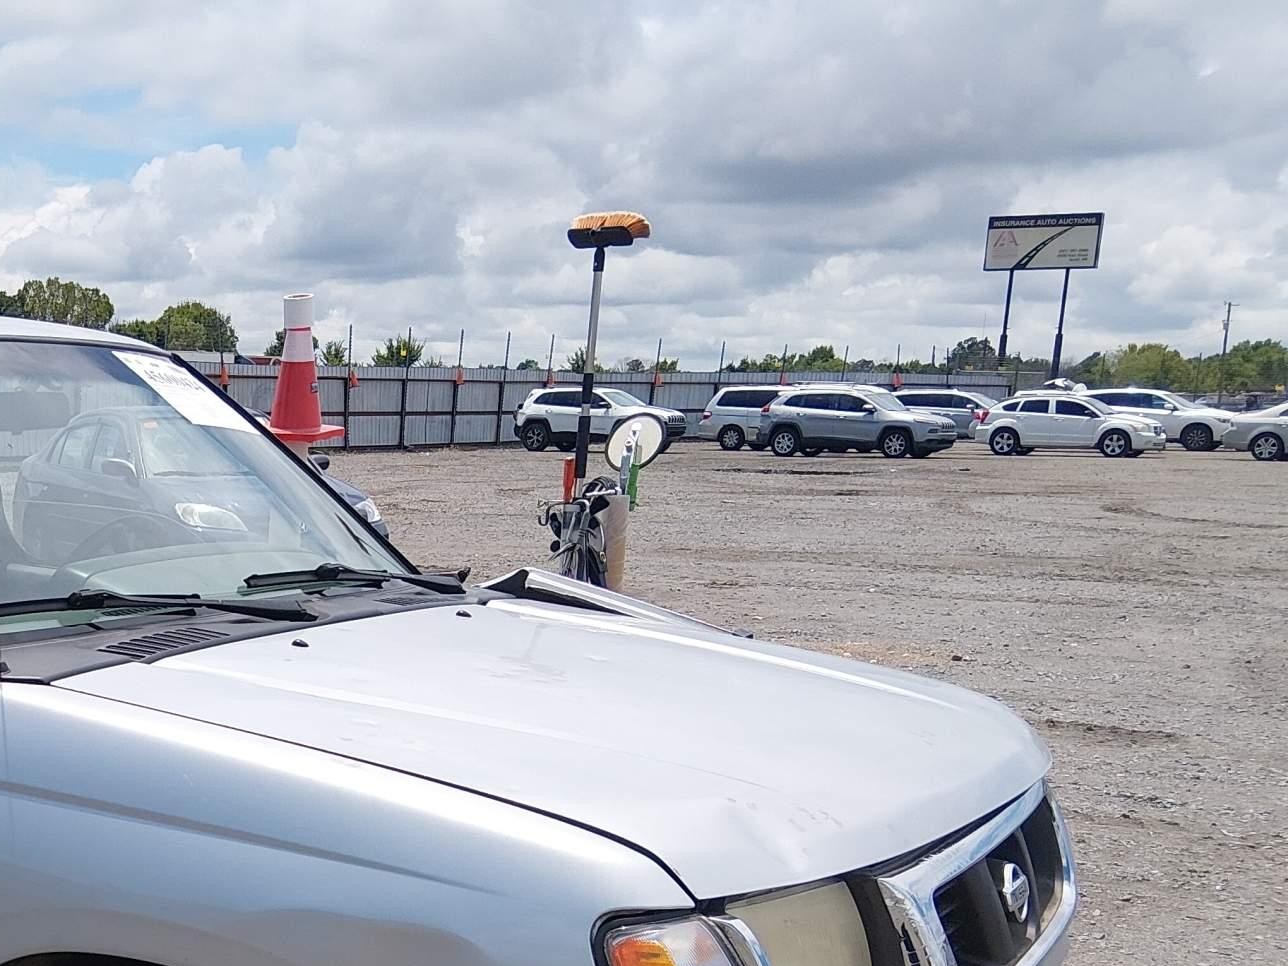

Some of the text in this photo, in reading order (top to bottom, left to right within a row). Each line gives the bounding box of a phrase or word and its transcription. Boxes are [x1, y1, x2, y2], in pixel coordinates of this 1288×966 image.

[993, 217, 1097, 227] INSURANCE AUTO AUCTIONS
